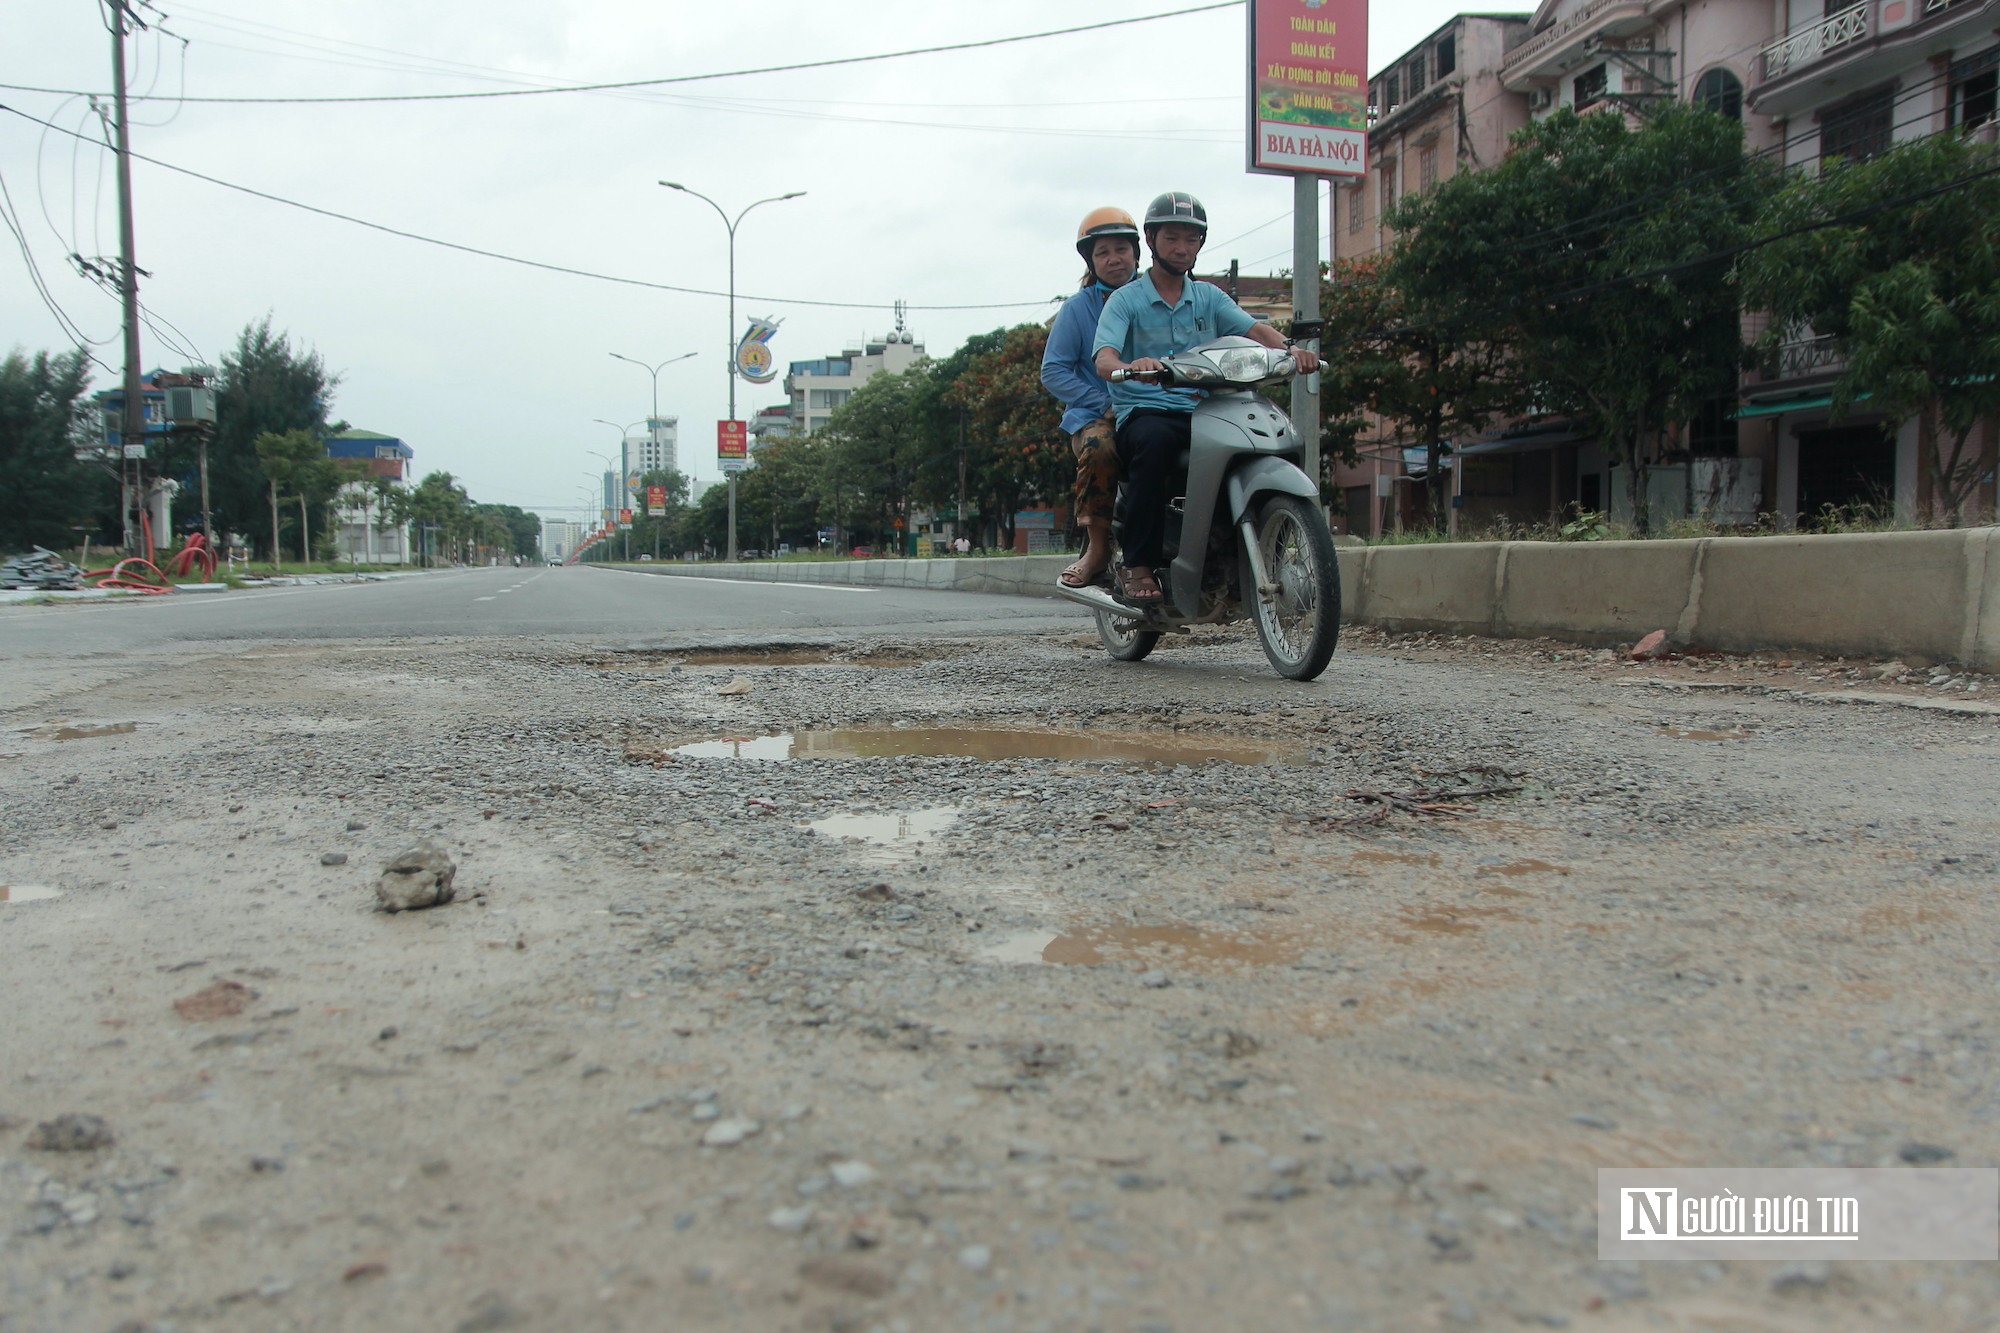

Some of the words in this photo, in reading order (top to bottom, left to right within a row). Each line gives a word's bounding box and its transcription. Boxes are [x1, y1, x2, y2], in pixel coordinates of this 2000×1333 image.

[1290, 15, 1314, 32] TOÀN
[1317, 17, 1336, 35] DÂN
[1291, 41, 1316, 58] ĐOÀN
[1319, 42, 1336, 60] KẾT
[1268, 62, 1286, 79] XÂY
[1288, 67, 1314, 84] DỰNG
[1316, 67, 1331, 85] ĐỜI
[1334, 69, 1358, 88] SỐNG
[1293, 92, 1313, 109] VĂN
[1315, 94, 1333, 112] HÓA
[1267, 134, 1297, 155] BIA
[1299, 134, 1325, 158] HÀ
[1327, 138, 1359, 165] NỘI
